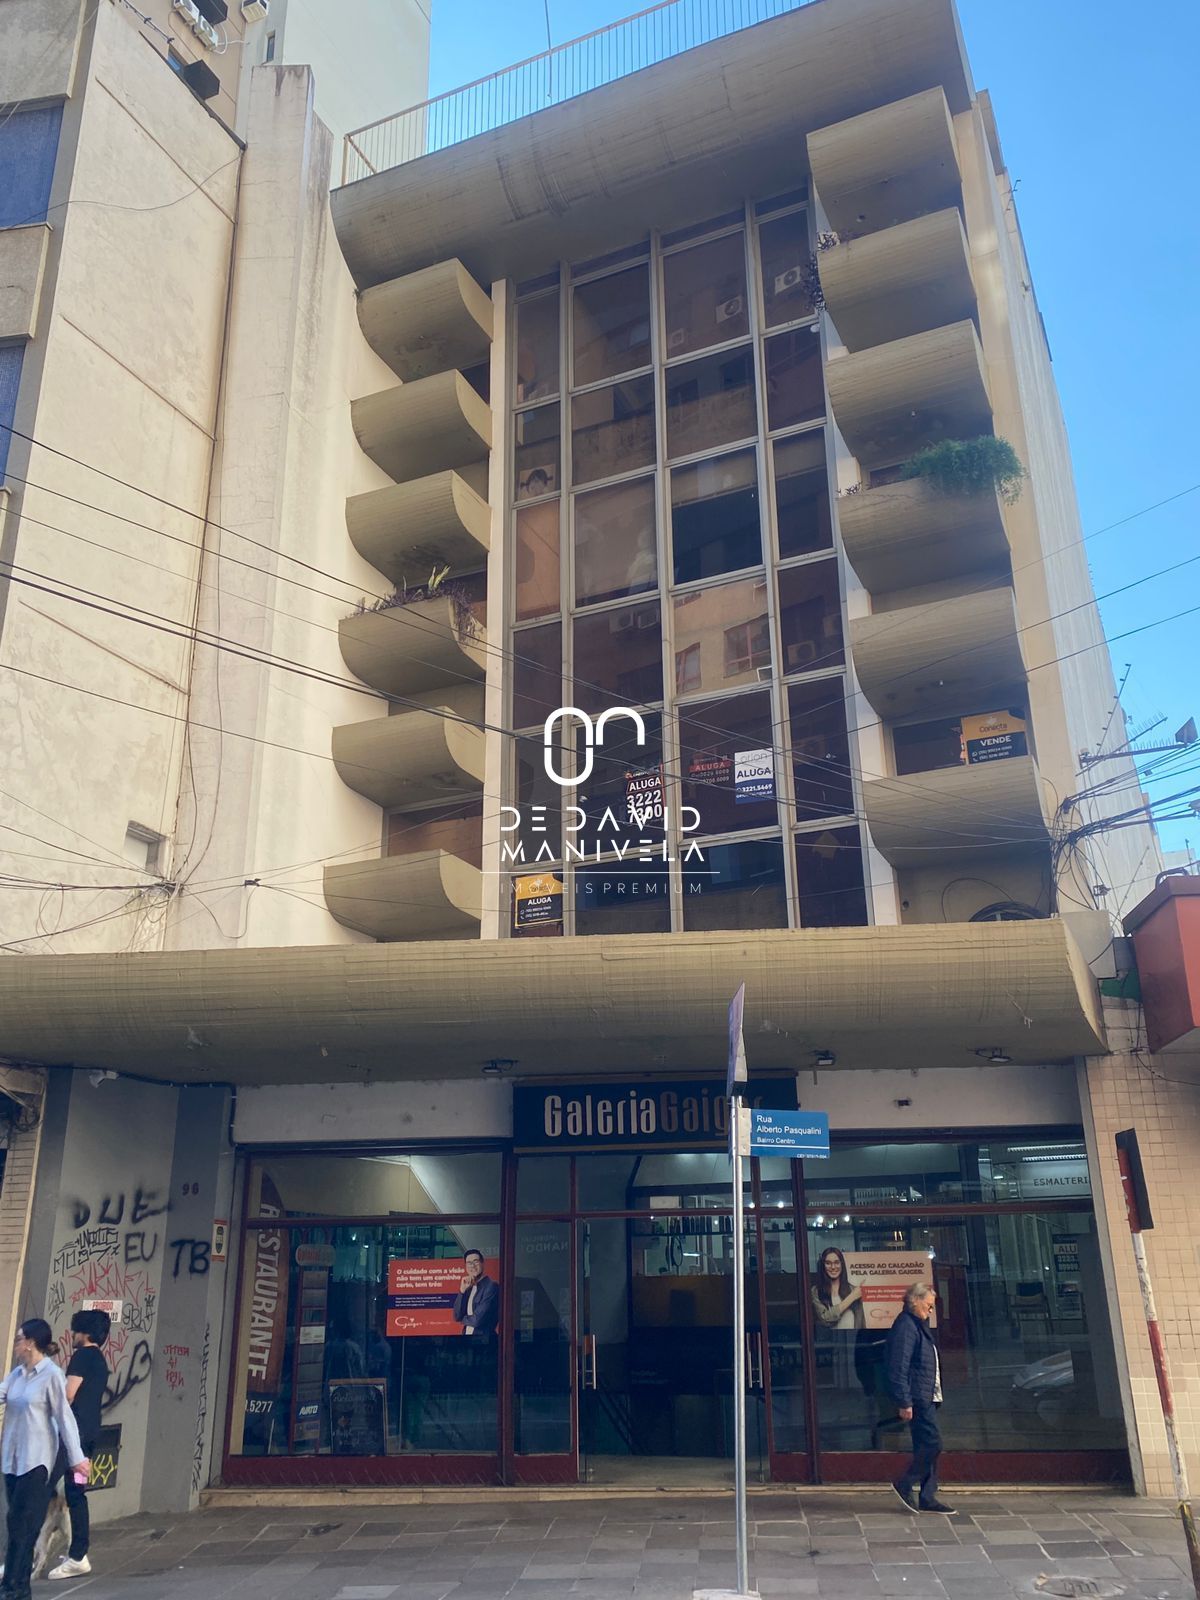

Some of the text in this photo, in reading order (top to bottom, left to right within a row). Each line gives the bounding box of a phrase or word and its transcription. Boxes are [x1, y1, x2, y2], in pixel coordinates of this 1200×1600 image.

[980, 735, 1012, 746] VENDE
[694, 762, 726, 772] ALUGA
[736, 766, 772, 779] ALUGA
[629, 776, 662, 792] ALUGA
[626, 789, 662, 809] 3222
[527, 896, 552, 906] ALUGA
[756, 1114, 773, 1124] Rua
[756, 1125, 822, 1136] Alberto Pasqualini
[756, 1136, 796, 1145] Bairro Centro
[1033, 1176, 1090, 1186] ESMALTERI
[125, 1231, 158, 1264] EU
[1057, 1245, 1077, 1253] ALU
[170, 1238, 210, 1281] TB
[403, 1267, 428, 1275] cuidado
[888, 1261, 925, 1270] CALÇADÃO
[248, 1203, 281, 1380] RSTAURANTE
[245, 1399, 274, 1413] .5277
